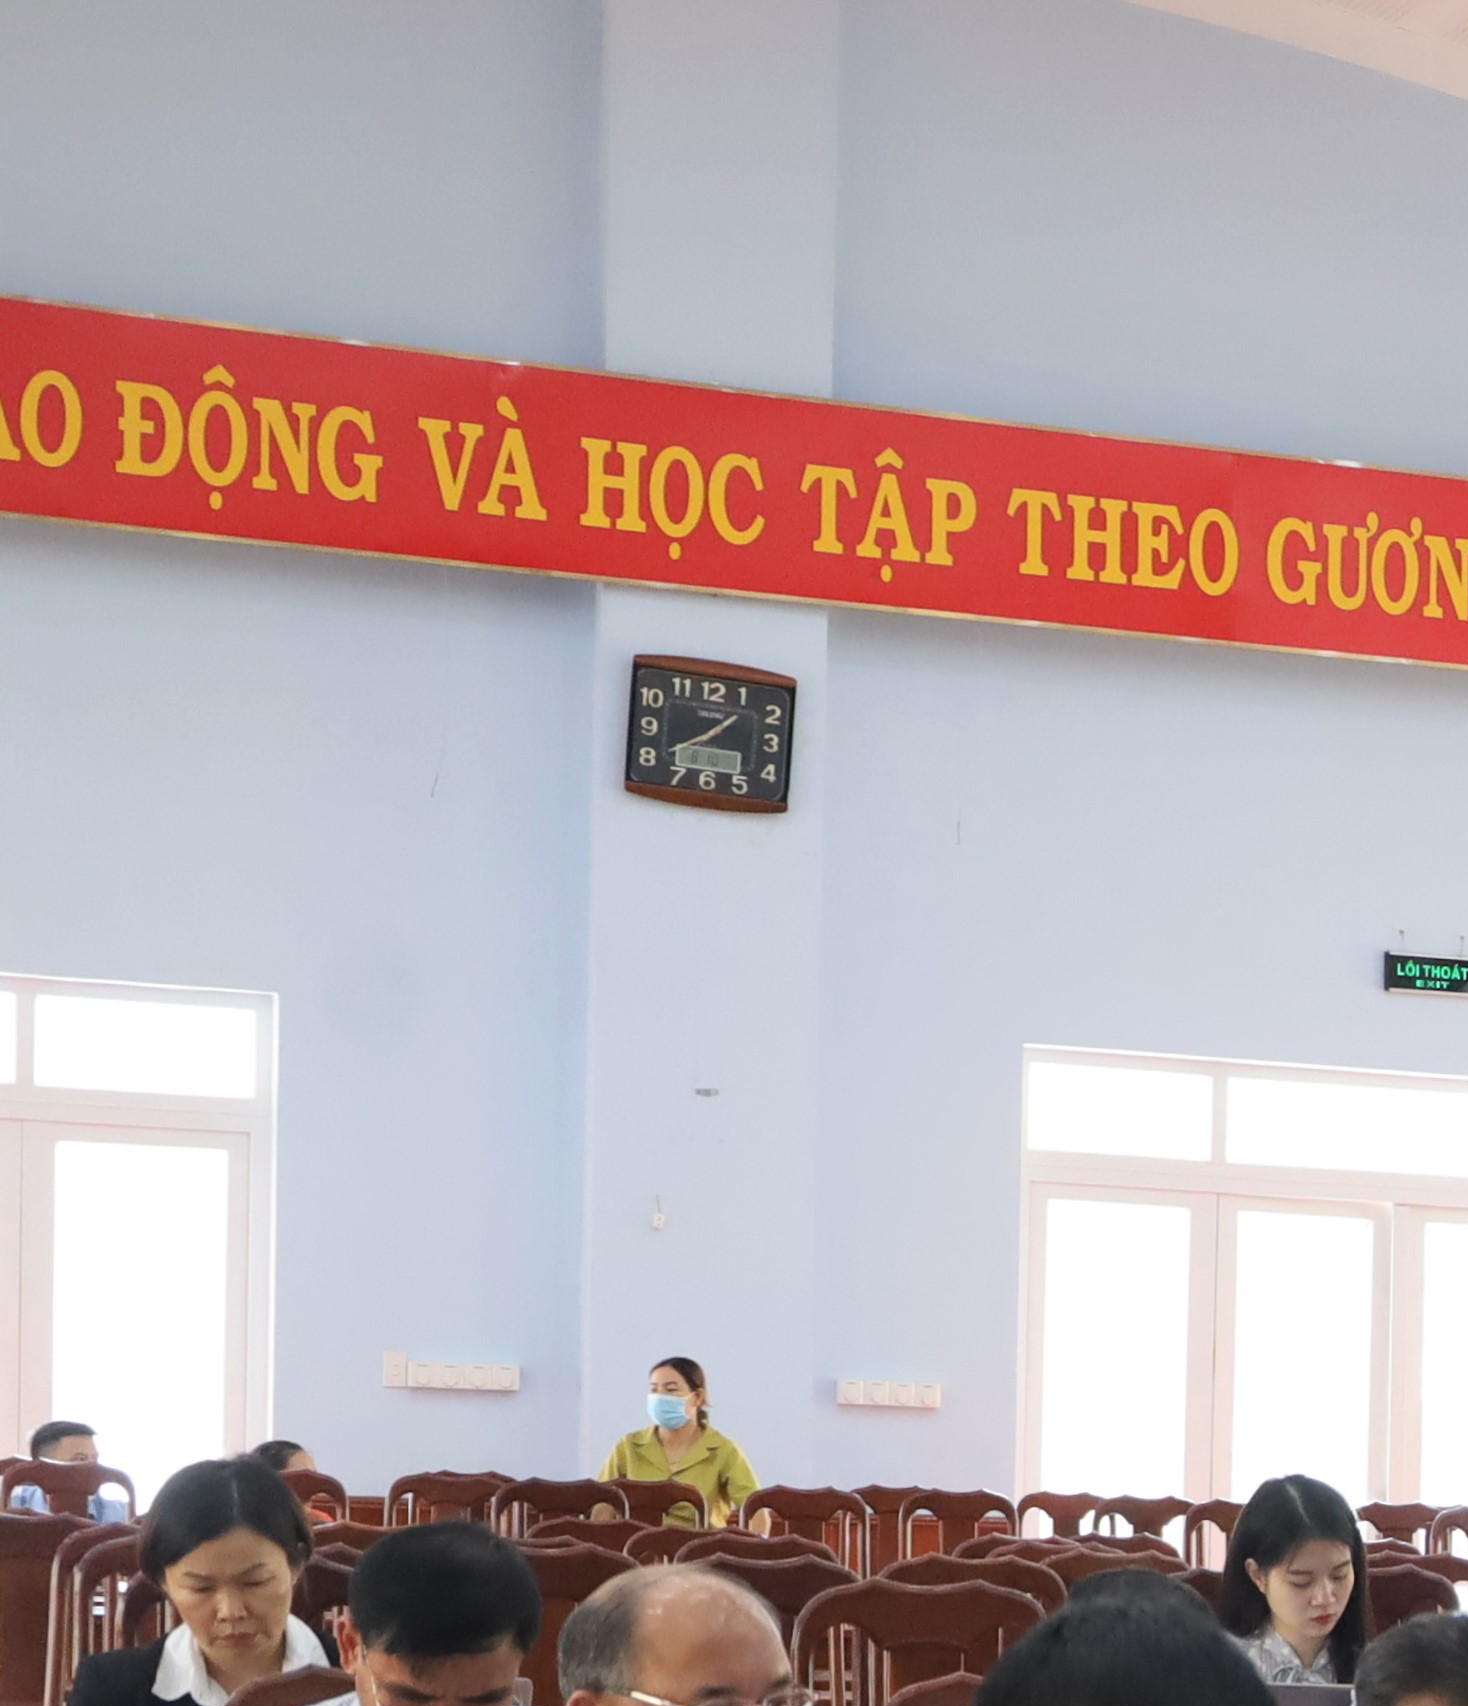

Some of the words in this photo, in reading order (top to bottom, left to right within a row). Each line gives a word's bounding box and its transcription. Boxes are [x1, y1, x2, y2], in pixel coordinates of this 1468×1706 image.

[115, 364, 383, 510] ĐỘNG
[418, 395, 548, 521] VÀ
[579, 437, 765, 560] HỌC
[800, 447, 977, 583] TẬP
[1006, 487, 1239, 596] THEO
[672, 677, 692, 698] 11
[701, 681, 726, 703] 12
[737, 687, 747, 706] 1
[640, 687, 664, 708] 10
[765, 705, 782, 725] 2
[641, 717, 658, 736] 9
[763, 734, 779, 753] 3
[639, 747, 656, 766] 8
[670, 767, 687, 786] 7
[699, 771, 716, 790] 6
[760, 764, 776, 783] 4
[731, 775, 749, 795] 5
[1415, 979, 1450, 989] EXIT
